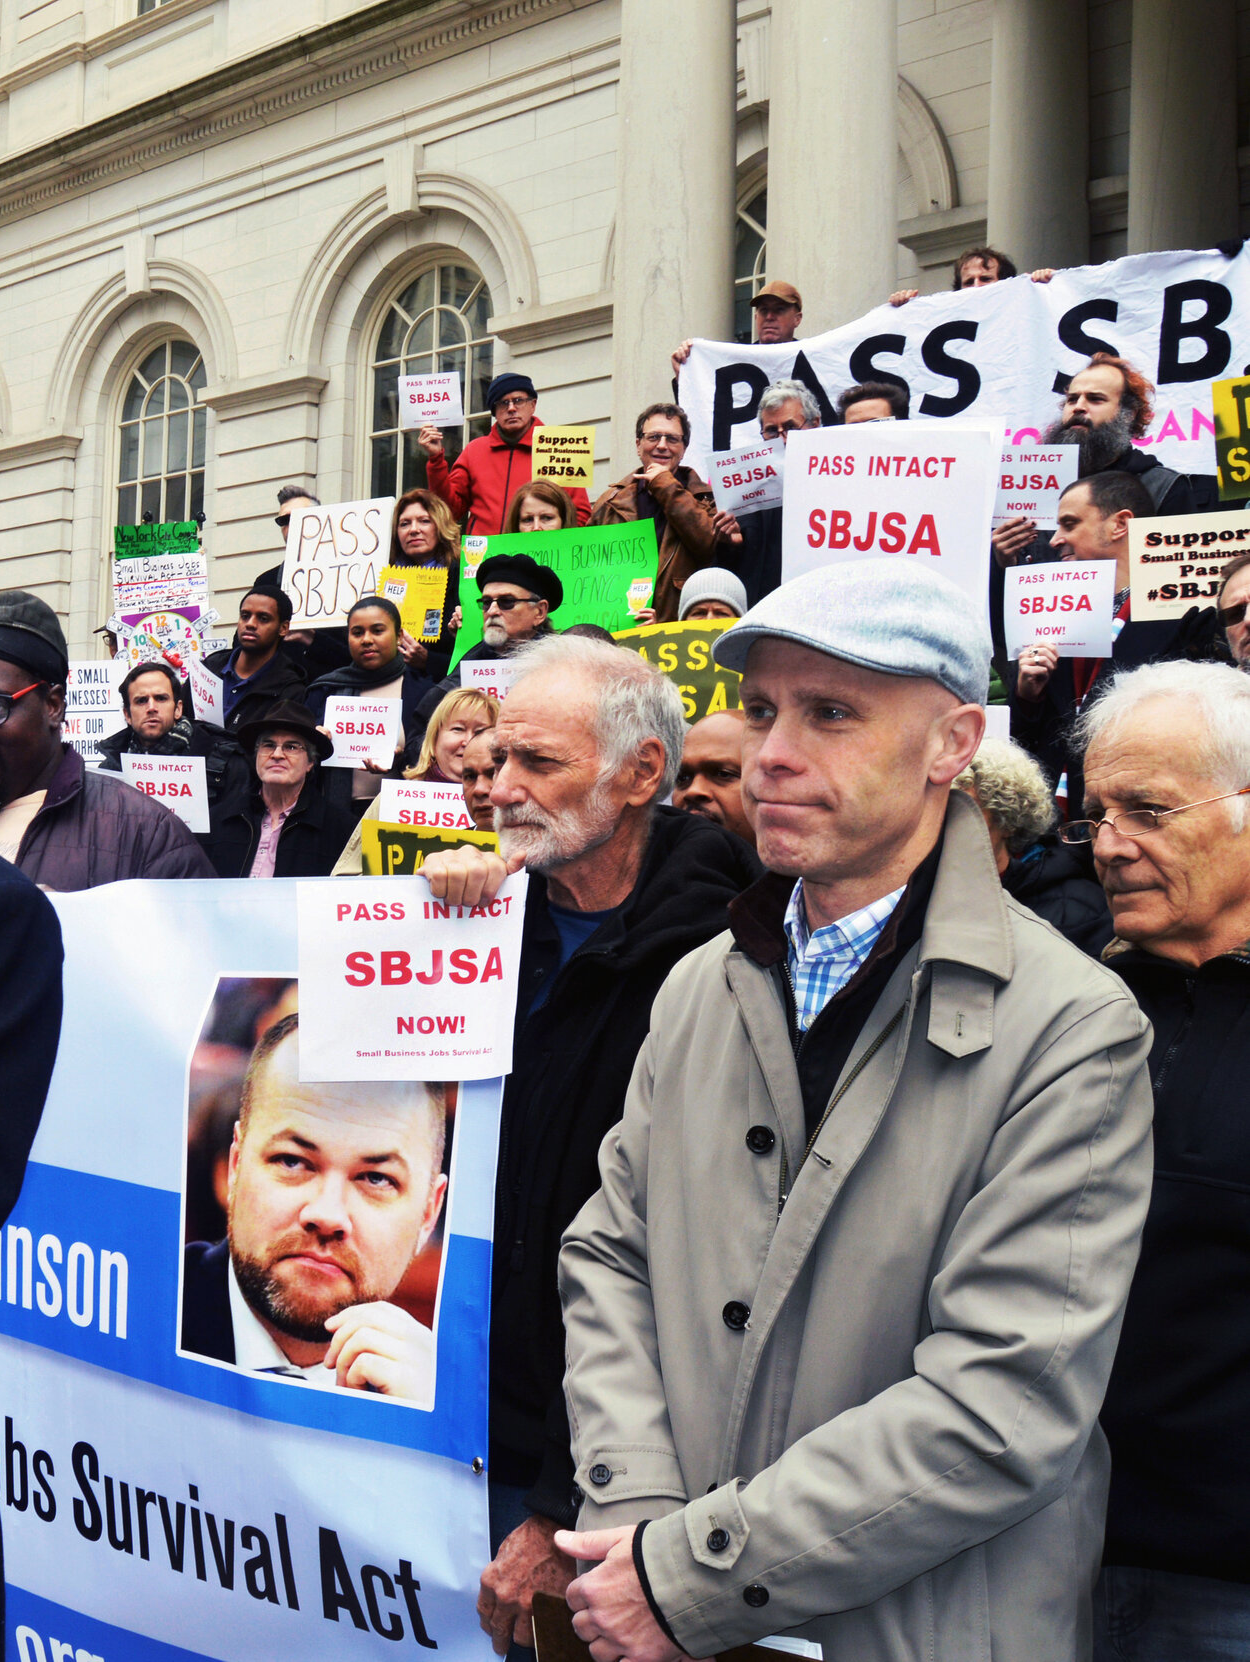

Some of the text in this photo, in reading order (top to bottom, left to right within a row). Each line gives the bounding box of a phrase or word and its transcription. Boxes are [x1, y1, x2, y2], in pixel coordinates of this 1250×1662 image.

[426, 378, 451, 386] INTACT
[409, 392, 451, 404] SBJSA
[538, 435, 588, 446] Support
[549, 455, 571, 463] Pass
[716, 447, 774, 468] PASS INTACT
[1020, 454, 1063, 463] INTACT
[807, 455, 956, 479] PASS INTACT
[722, 465, 777, 488] SBJSA
[997, 474, 1060, 490] BJSA
[742, 489, 766, 501] NOW!
[1006, 502, 1037, 511] NOW!
[297, 509, 381, 562] PASS
[806, 508, 942, 557] SBJSA
[1145, 529, 1250, 547] Suppor
[1140, 552, 1184, 563] Small
[114, 558, 139, 574] Small
[1018, 571, 1098, 584] PASS INTACT
[388, 586, 404, 595] HELP
[1147, 581, 1219, 601] #SBJ
[1019, 594, 1092, 615] SBJSA
[155, 615, 167, 627] 12
[175, 619, 180, 630] 1
[142, 623, 152, 634] 11
[185, 627, 192, 638] 2
[1035, 626, 1066, 636] NOW!
[134, 634, 147, 646] 10
[191, 640, 198, 651] 3
[131, 648, 139, 659] 9
[78, 668, 110, 684] SMALL
[180, 667, 188, 678] 5
[359, 705, 389, 713] INTACT
[63, 719, 104, 734] AVE OUR
[335, 722, 386, 736] SBJSA
[132, 763, 193, 772] PASS INTACT
[136, 781, 193, 797] SBJSA
[397, 789, 426, 799] PASS
[398, 810, 471, 828] SBJSA
[336, 896, 513, 922] PASS INTACT
[344, 947, 504, 987] SBJSA
[396, 1016, 466, 1034] NOW!
[384, 1049, 426, 1057] Business
[428, 1049, 450, 1057] Jobs
[452, 1048, 482, 1056] Survival
[71, 1440, 301, 1611] Survival
[318, 1525, 439, 1650] Act
